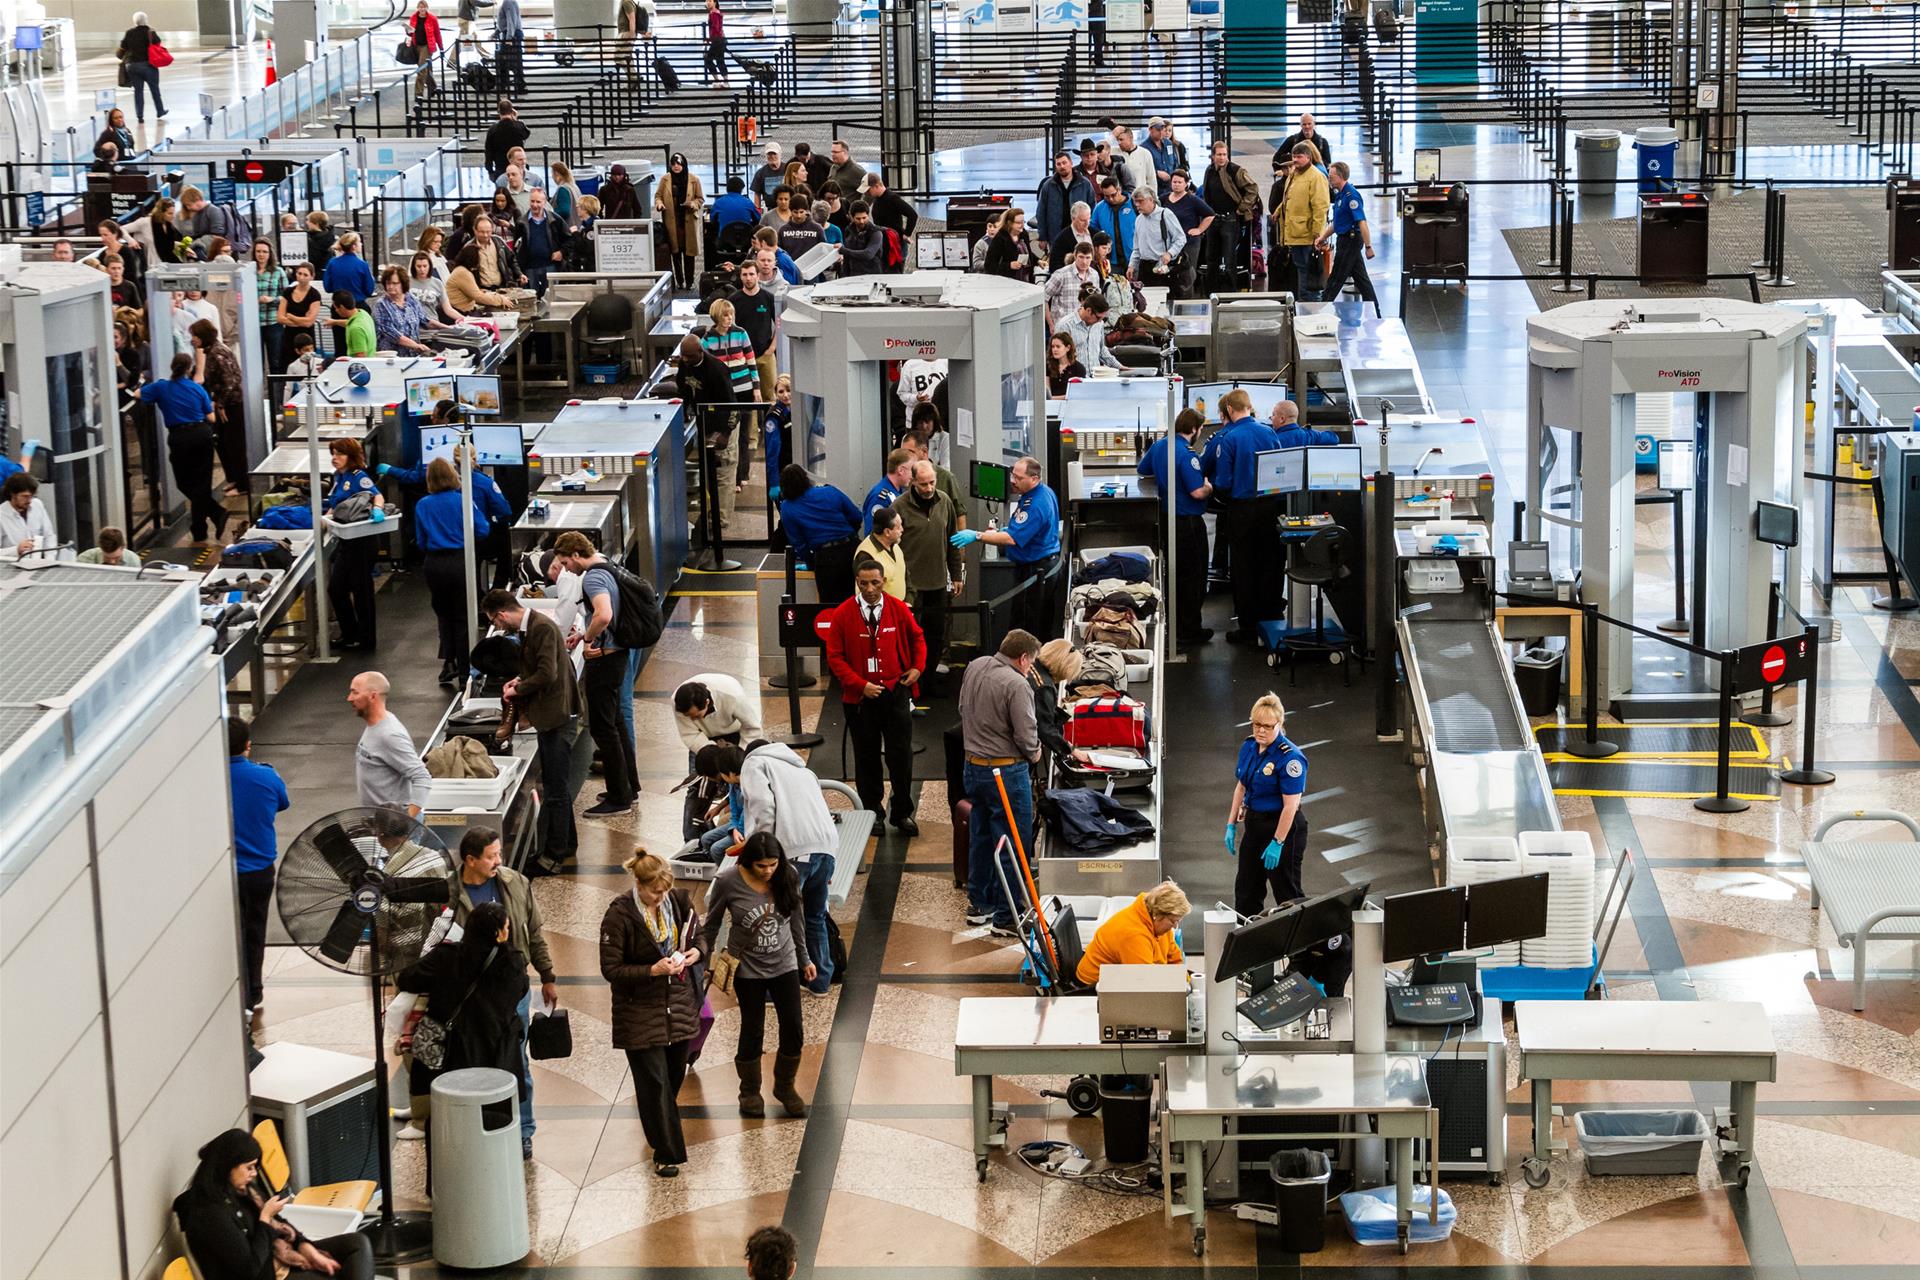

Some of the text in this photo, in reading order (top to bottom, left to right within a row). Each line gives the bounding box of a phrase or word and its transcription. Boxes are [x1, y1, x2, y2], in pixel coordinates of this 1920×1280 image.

[612, 244, 633, 253] 1937
[918, 347, 936, 355] ATD
[1168, 379, 1174, 390] 5
[1680, 378, 1700, 386] ATD
[1381, 434, 1387, 445] 6
[758, 935, 778, 947] RAMS
